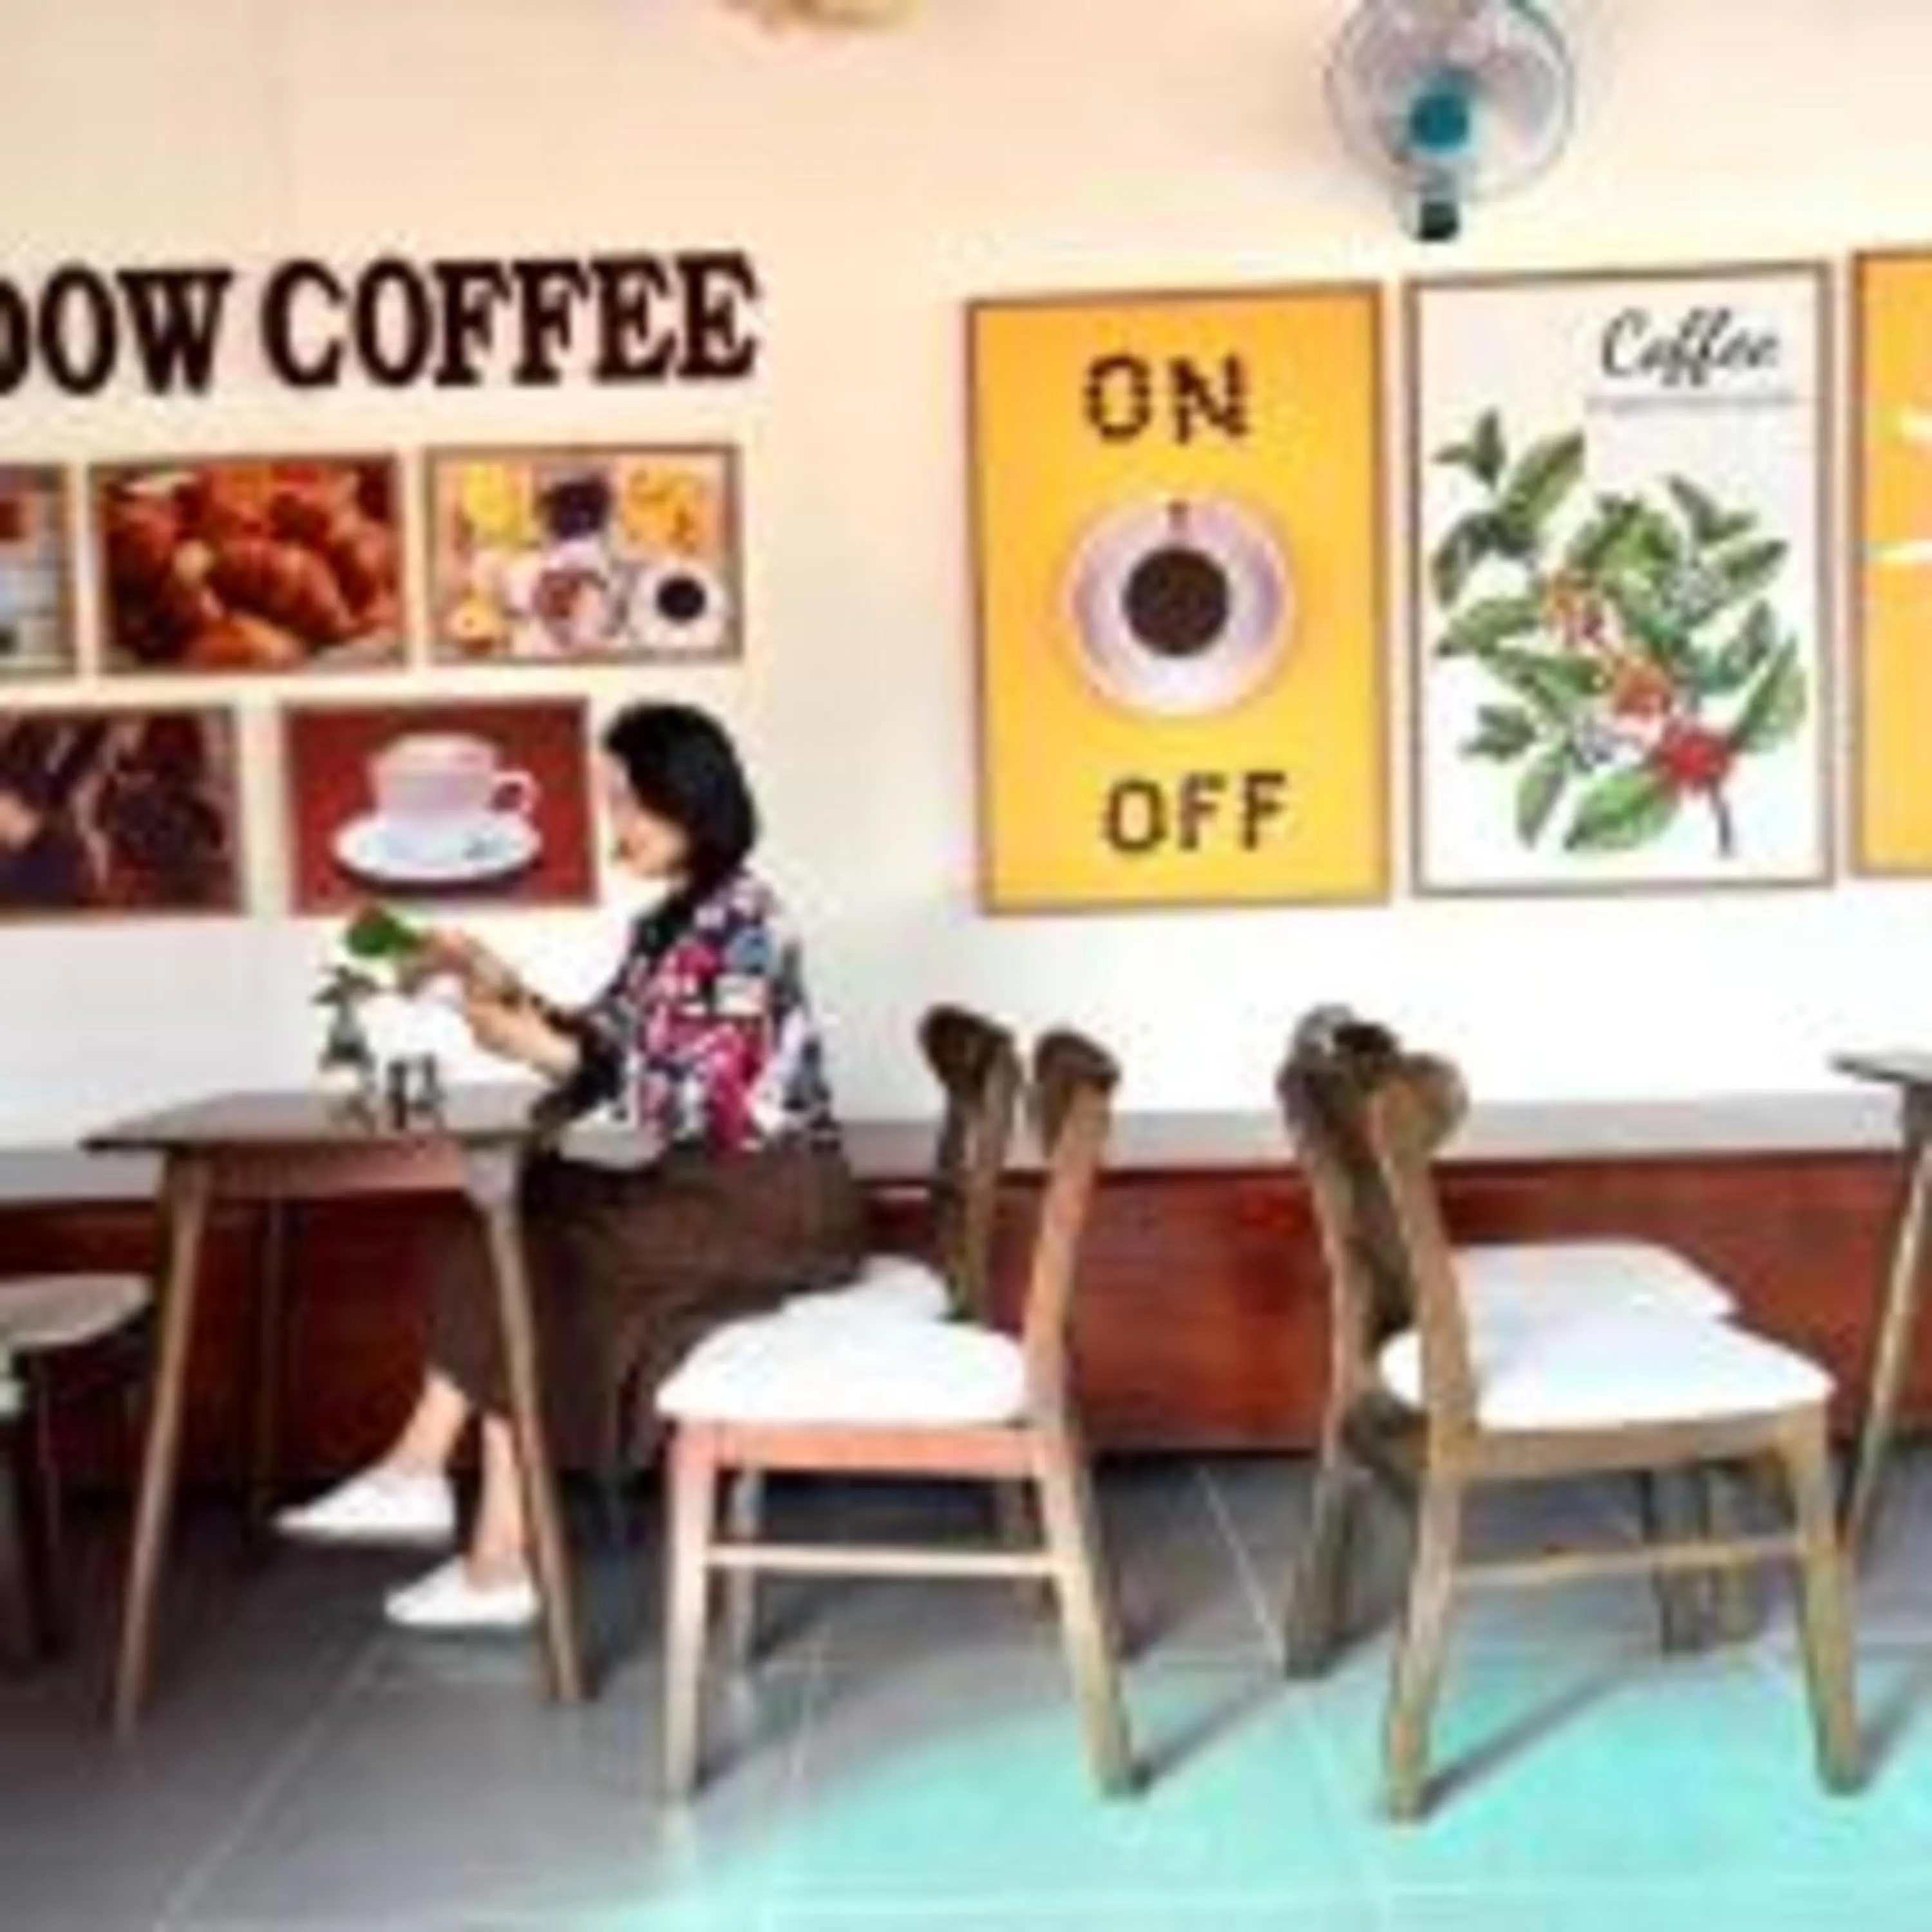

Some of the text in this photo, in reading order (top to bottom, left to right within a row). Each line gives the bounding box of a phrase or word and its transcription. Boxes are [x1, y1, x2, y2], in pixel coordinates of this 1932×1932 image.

[261, 251, 758, 388] COFFEE
[1601, 307, 1780, 387] Coffee
[1084, 352, 1249, 445] ON
[1103, 771, 1287, 855] OFF
